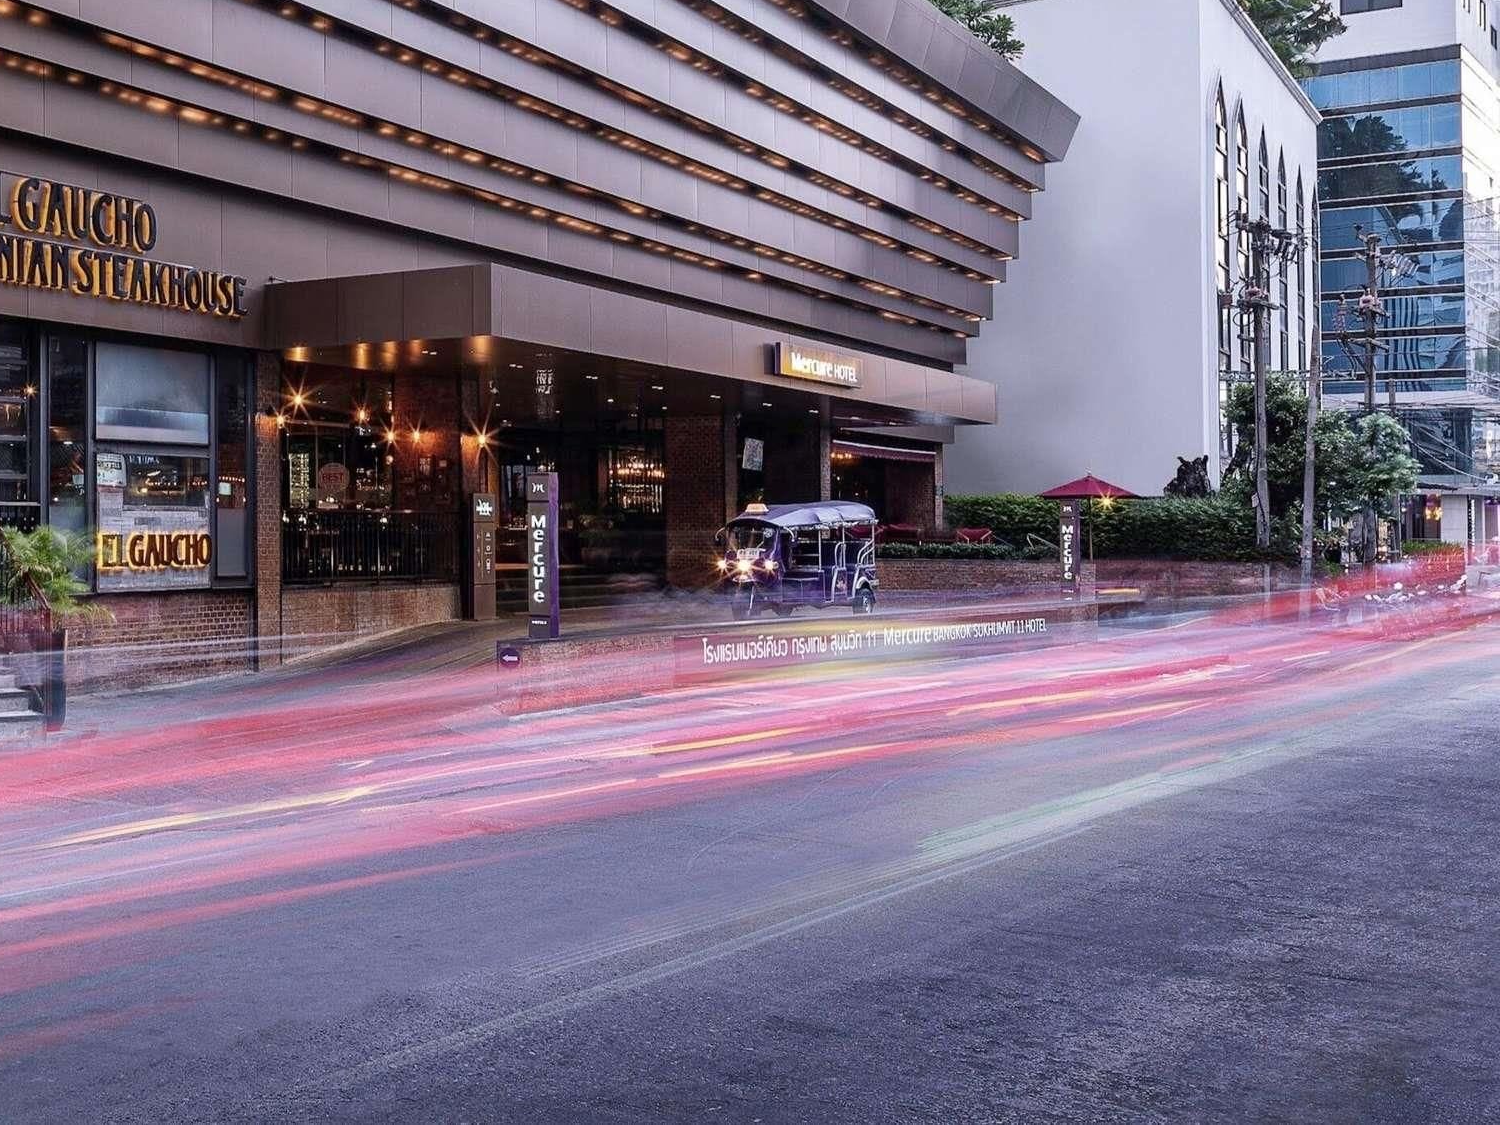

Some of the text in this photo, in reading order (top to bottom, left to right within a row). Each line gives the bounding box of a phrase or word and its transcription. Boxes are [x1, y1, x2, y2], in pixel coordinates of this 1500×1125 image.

[13, 177, 157, 253] GAUCHO
[72, 249, 249, 317] STEAKHOUSE
[791, 352, 858, 383] Mercure HOTEL
[101, 532, 212, 567] EL GAUCHO
[531, 514, 546, 603] Mercure
[1061, 524, 1074, 580] Mercure
[884, 627, 931, 646] Mercure
[933, 623, 971, 642] BANGKOK
[973, 620, 1015, 638] SUKHUMVIT
[1016, 619, 1024, 634] 11
[1025, 618, 1047, 633] HOTEL
